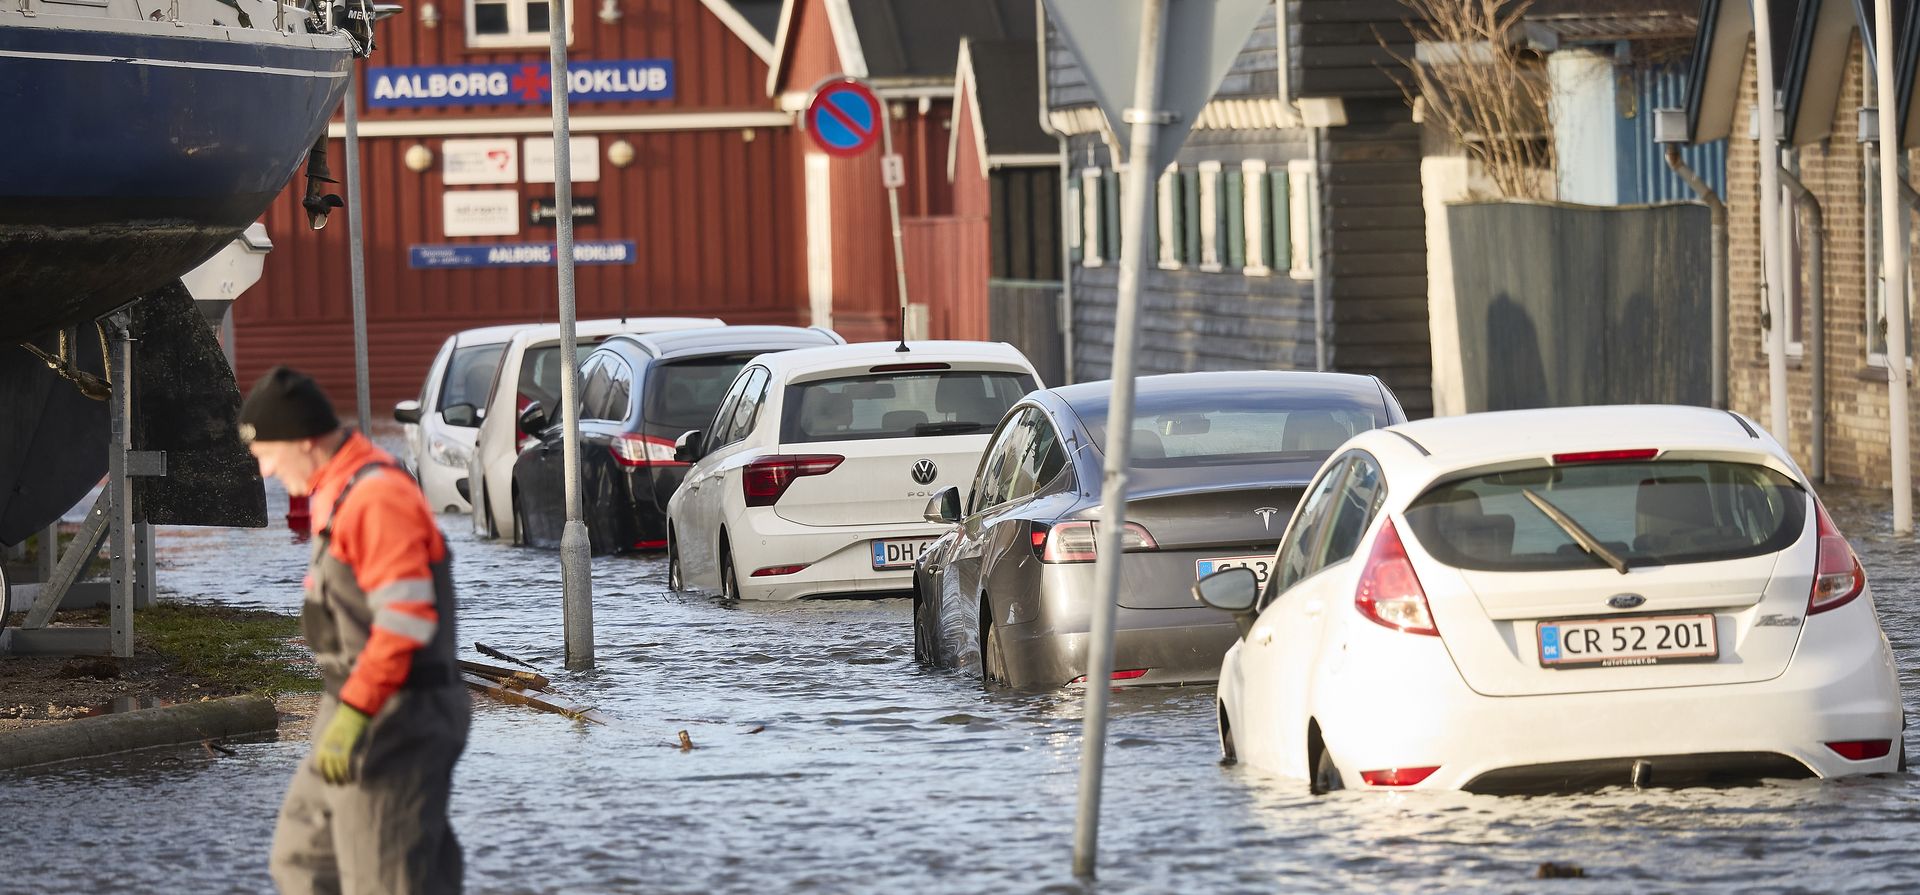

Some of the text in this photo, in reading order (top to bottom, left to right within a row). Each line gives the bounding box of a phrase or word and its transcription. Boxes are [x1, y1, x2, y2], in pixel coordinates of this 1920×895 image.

[374, 72, 508, 99] AALBORG
[488, 247, 551, 263] AALBORG
[887, 543, 914, 562] DH
[1544, 623, 1707, 655] DK CR 52 201
